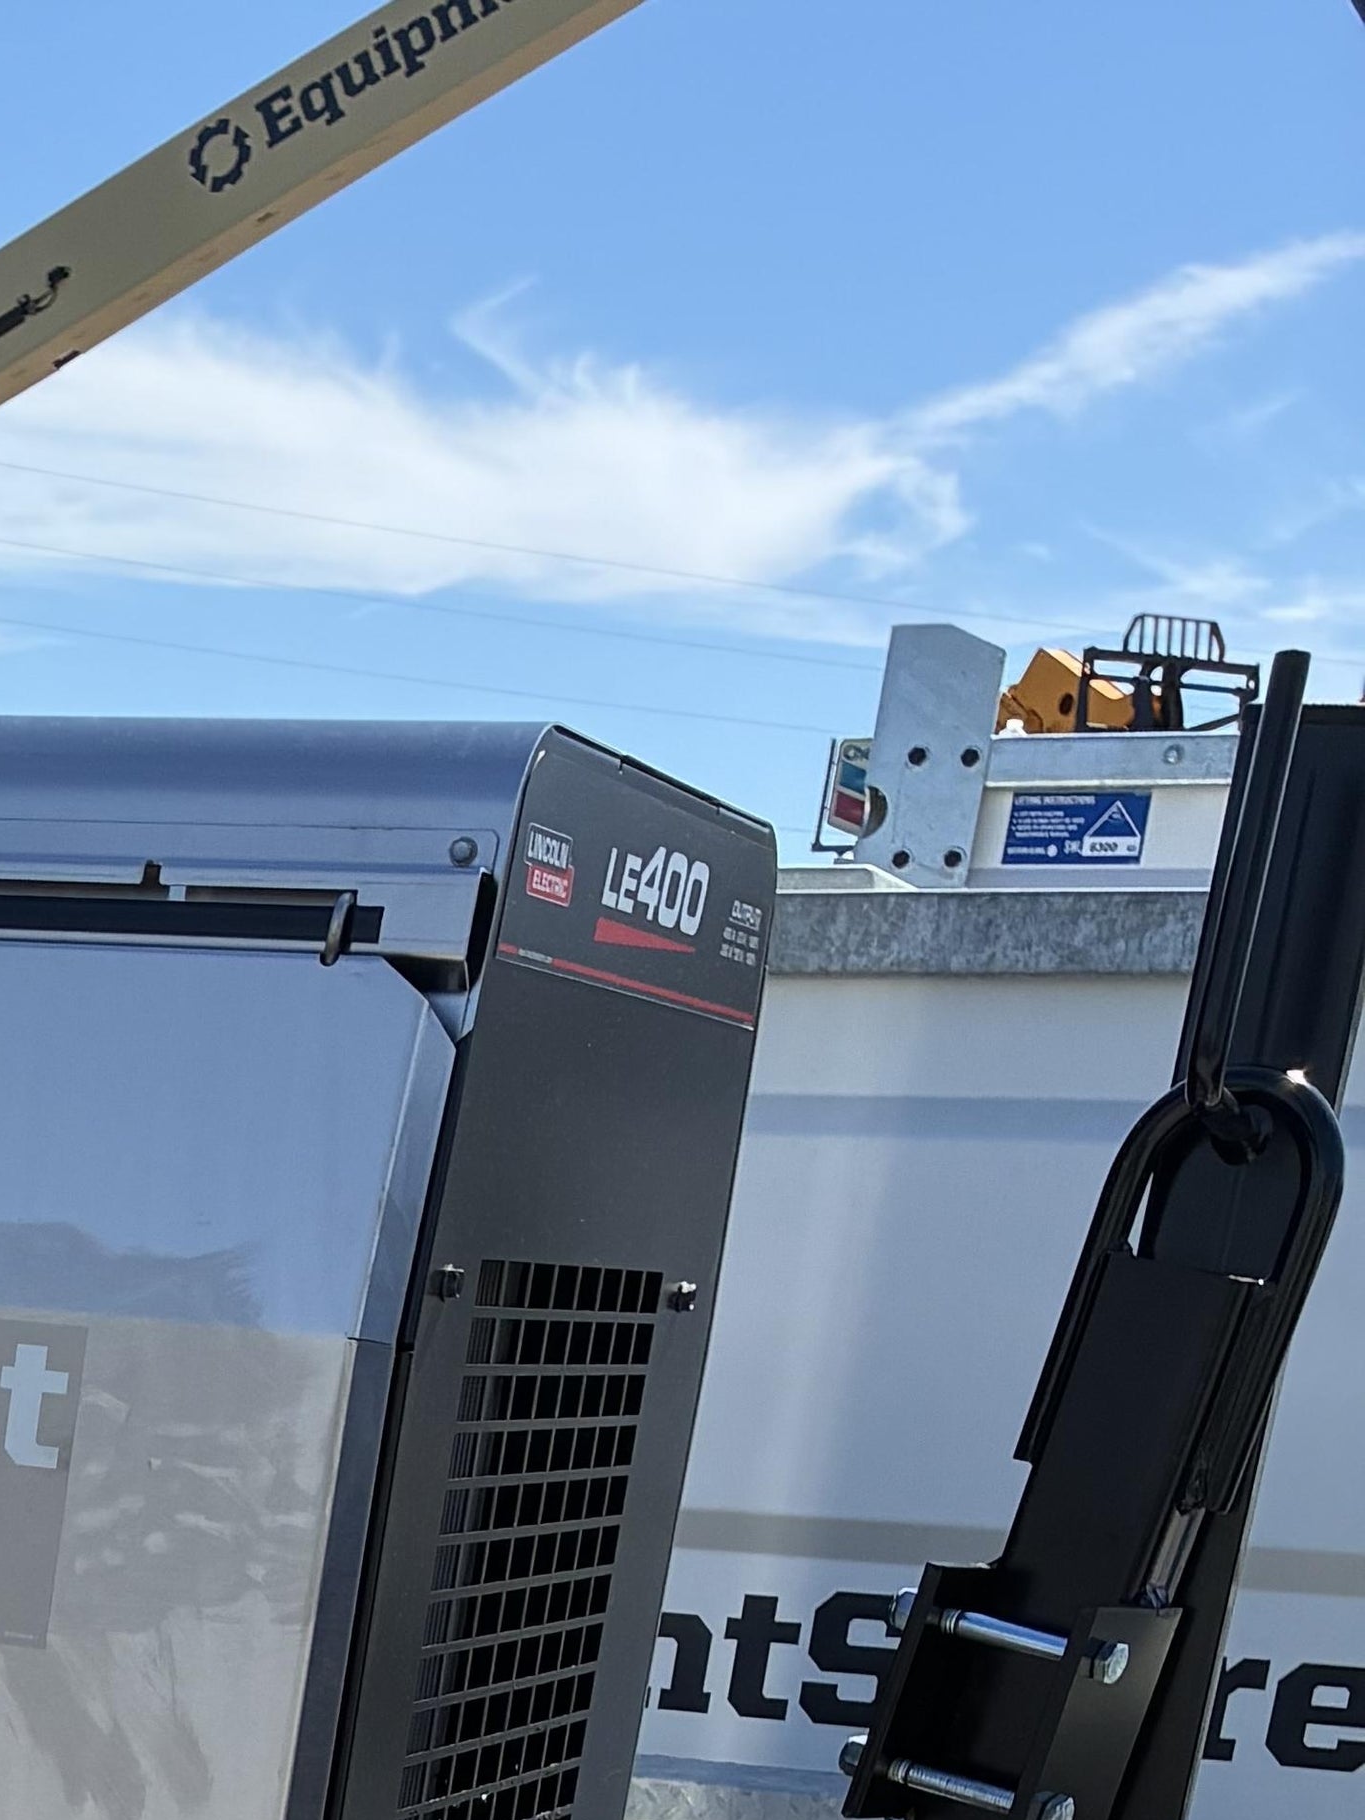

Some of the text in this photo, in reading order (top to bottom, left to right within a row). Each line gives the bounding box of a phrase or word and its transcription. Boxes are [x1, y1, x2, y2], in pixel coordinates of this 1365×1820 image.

[255, 0, 510, 148] Equipm
[528, 831, 569, 869] LINCOLN
[601, 846, 710, 936] LE400
